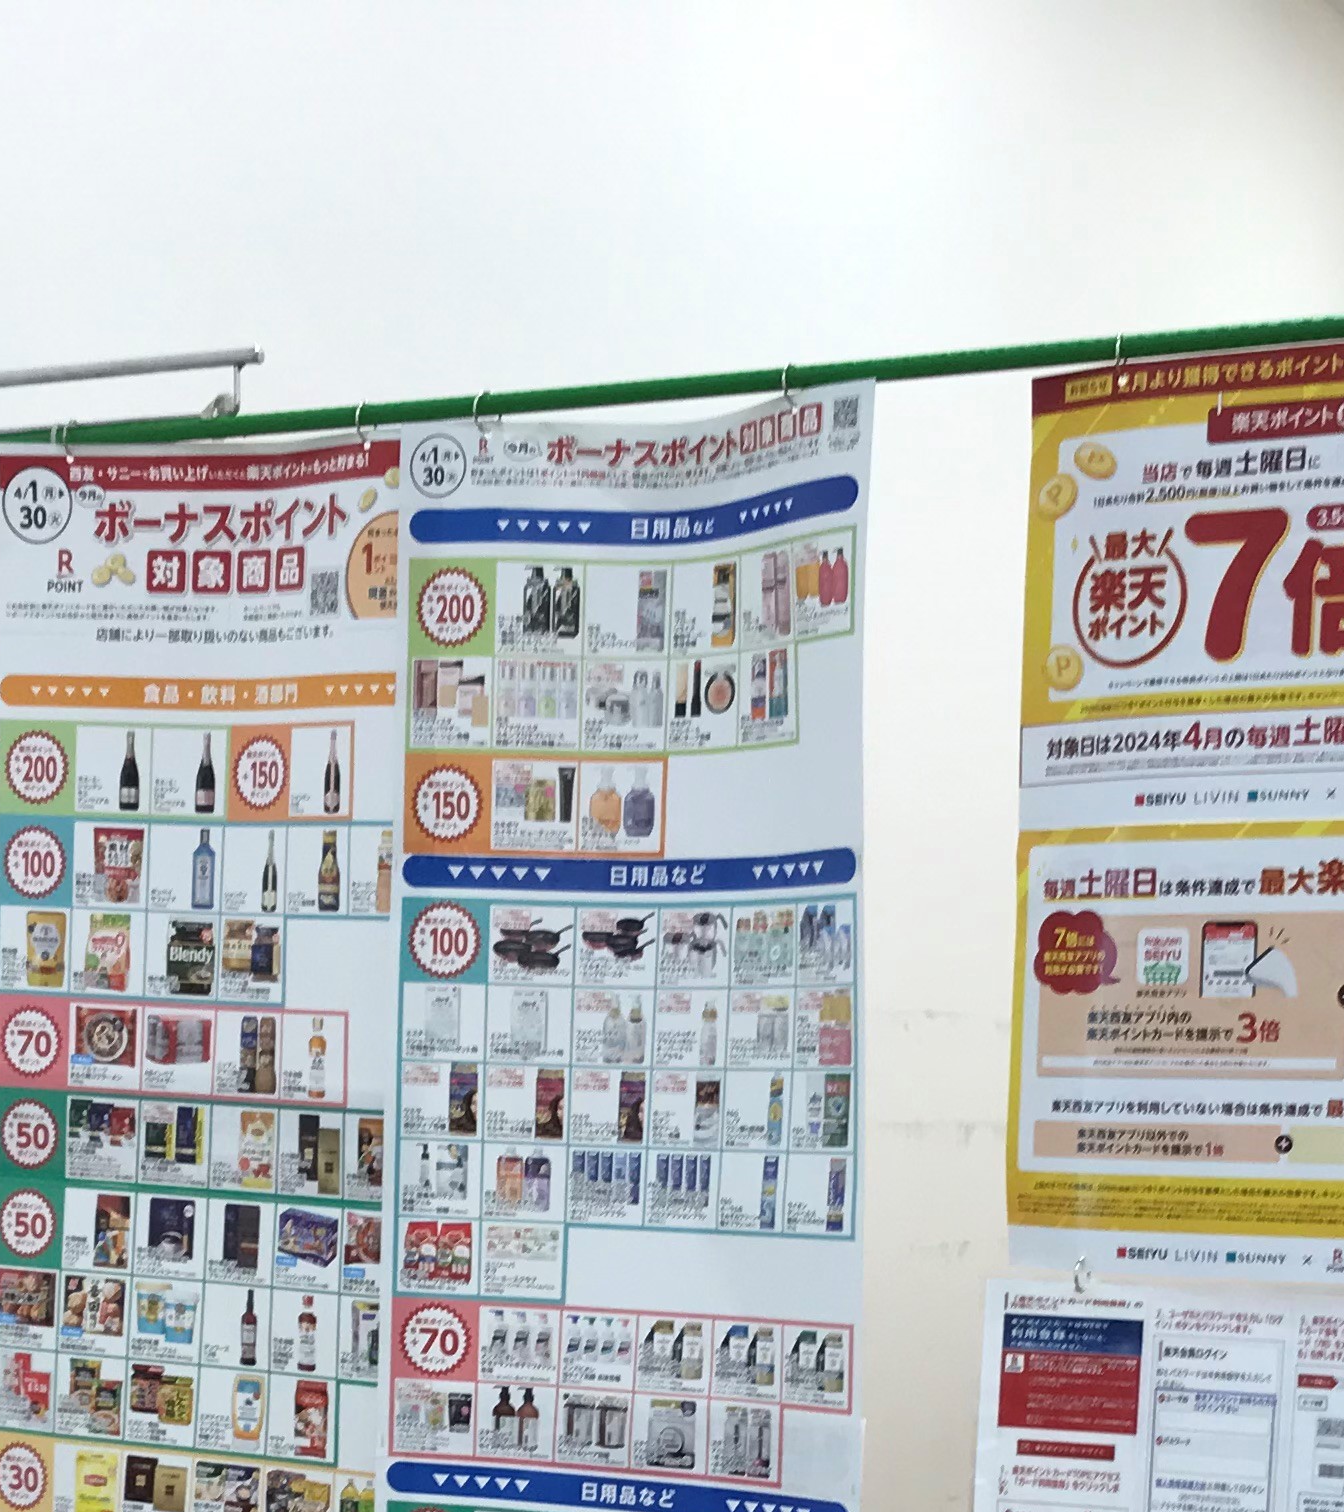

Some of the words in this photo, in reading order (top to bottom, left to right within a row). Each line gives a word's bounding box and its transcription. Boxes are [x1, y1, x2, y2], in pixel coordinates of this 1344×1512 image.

[546, 433, 737, 469] ボーナスポイント
[423, 468, 445, 486] 30
[1142, 447, 1321, 485] 当店で毎週土曜日に
[19, 505, 48, 530] 30
[93, 492, 349, 544] ボーナスポイント
[630, 516, 716, 540] 日用品など
[1103, 532, 1157, 560] 最大
[47, 580, 83, 593] POINT
[1090, 568, 1167, 610] 楽天
[435, 594, 475, 624] 200
[1088, 614, 1165, 643] ポイント
[22, 755, 57, 783] 200
[250, 762, 279, 789] 150
[432, 791, 471, 820] 150
[1146, 792, 1186, 806] SEIYU
[1194, 791, 1239, 805] LIVIN
[1259, 789, 1309, 802] SUNNY
[22, 850, 55, 878] 100
[609, 864, 707, 887] 日用品など
[169, 945, 214, 964] Blendy
[429, 927, 469, 956] 100
[18, 1030, 52, 1055] 70
[16, 1123, 50, 1148] 50
[14, 1212, 48, 1238] 50
[1127, 1248, 1168, 1262] SEIYU
[1174, 1250, 1218, 1264] LIVIN
[1237, 1252, 1287, 1265] SUNNY
[419, 1327, 459, 1355] 70
[9, 1463, 39, 1493] 30
[581, 1481, 675, 1509] 日用品など
